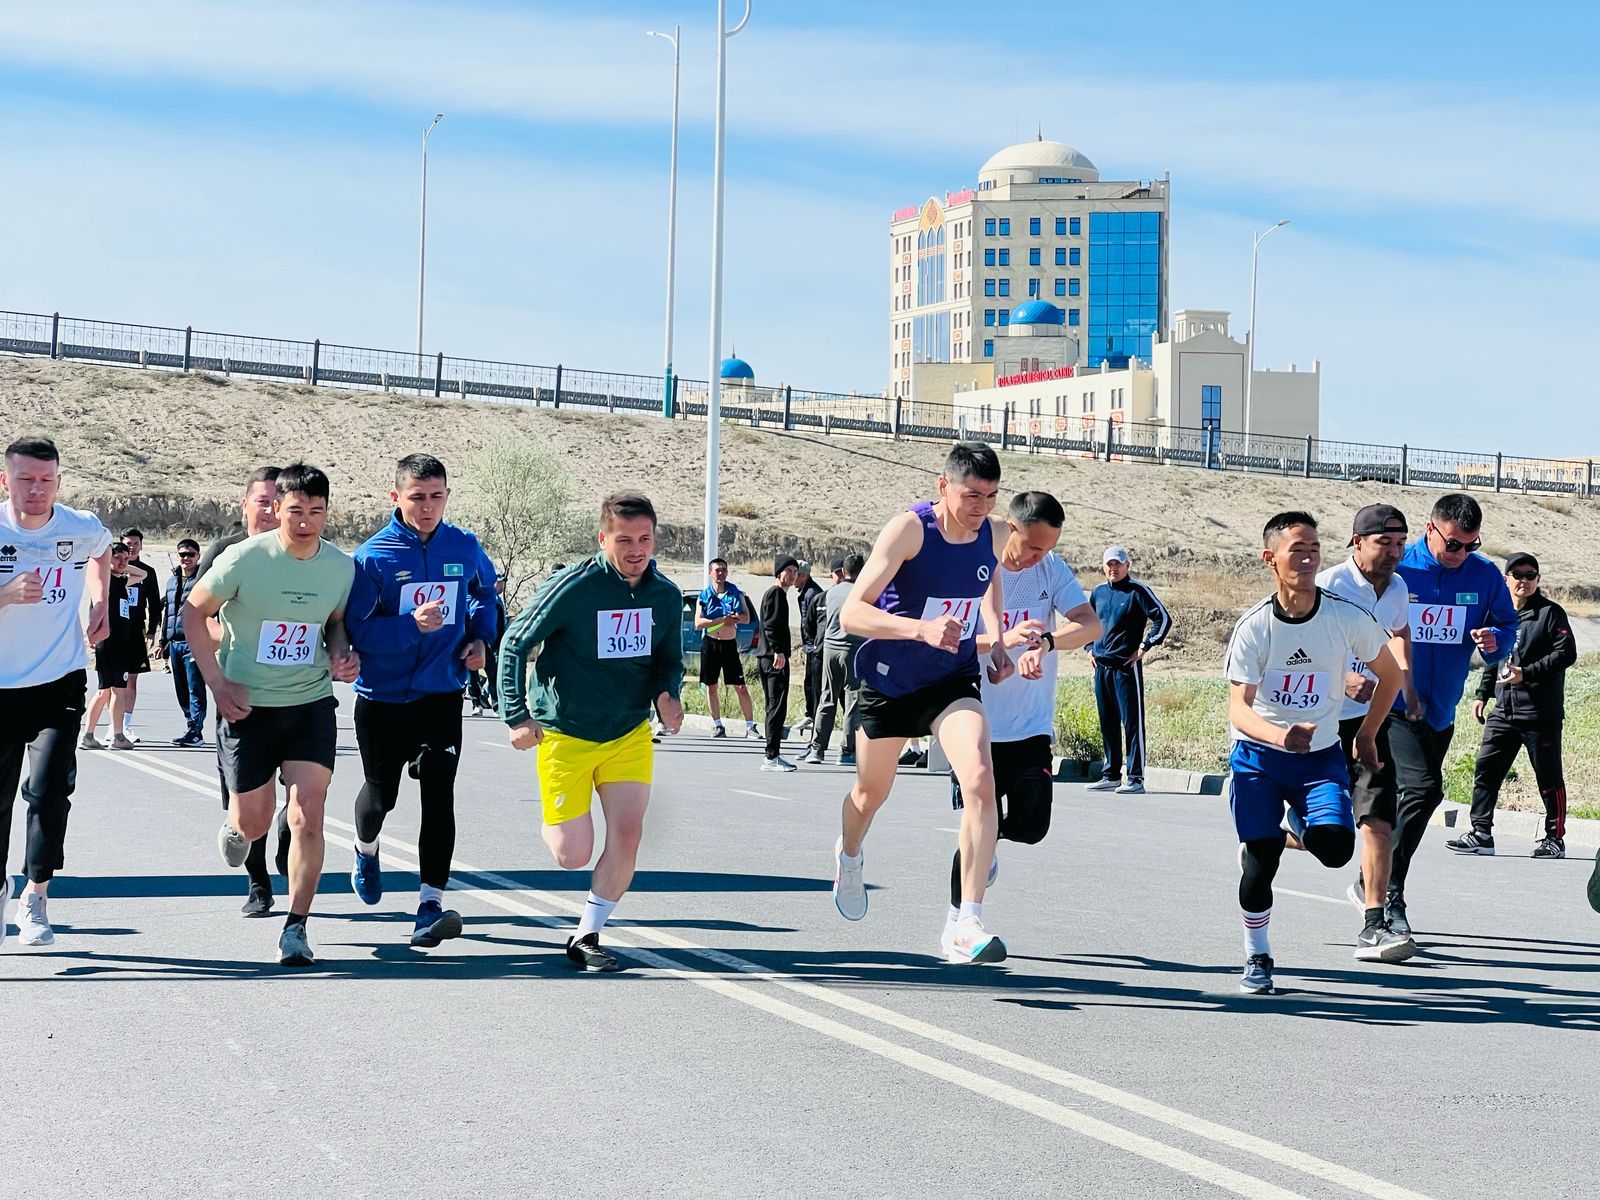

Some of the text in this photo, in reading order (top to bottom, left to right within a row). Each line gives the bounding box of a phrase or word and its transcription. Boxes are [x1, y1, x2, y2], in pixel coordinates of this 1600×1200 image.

[42, 588, 66, 604] -39
[413, 585, 446, 607] 6/2
[941, 600, 972, 622] 2/1
[1421, 606, 1453, 627] 6/1
[611, 612, 640, 635] 7/1
[273, 623, 307, 645] 2/2
[1415, 626, 1457, 641] 30-39
[607, 635, 646, 652] 30-39
[267, 645, 310, 661] 30-39
[1285, 658, 1312, 666] adidas
[1351, 661, 1368, 674] 30-
[1281, 673, 1315, 694] 1/1
[1270, 690, 1320, 708] 30-39
